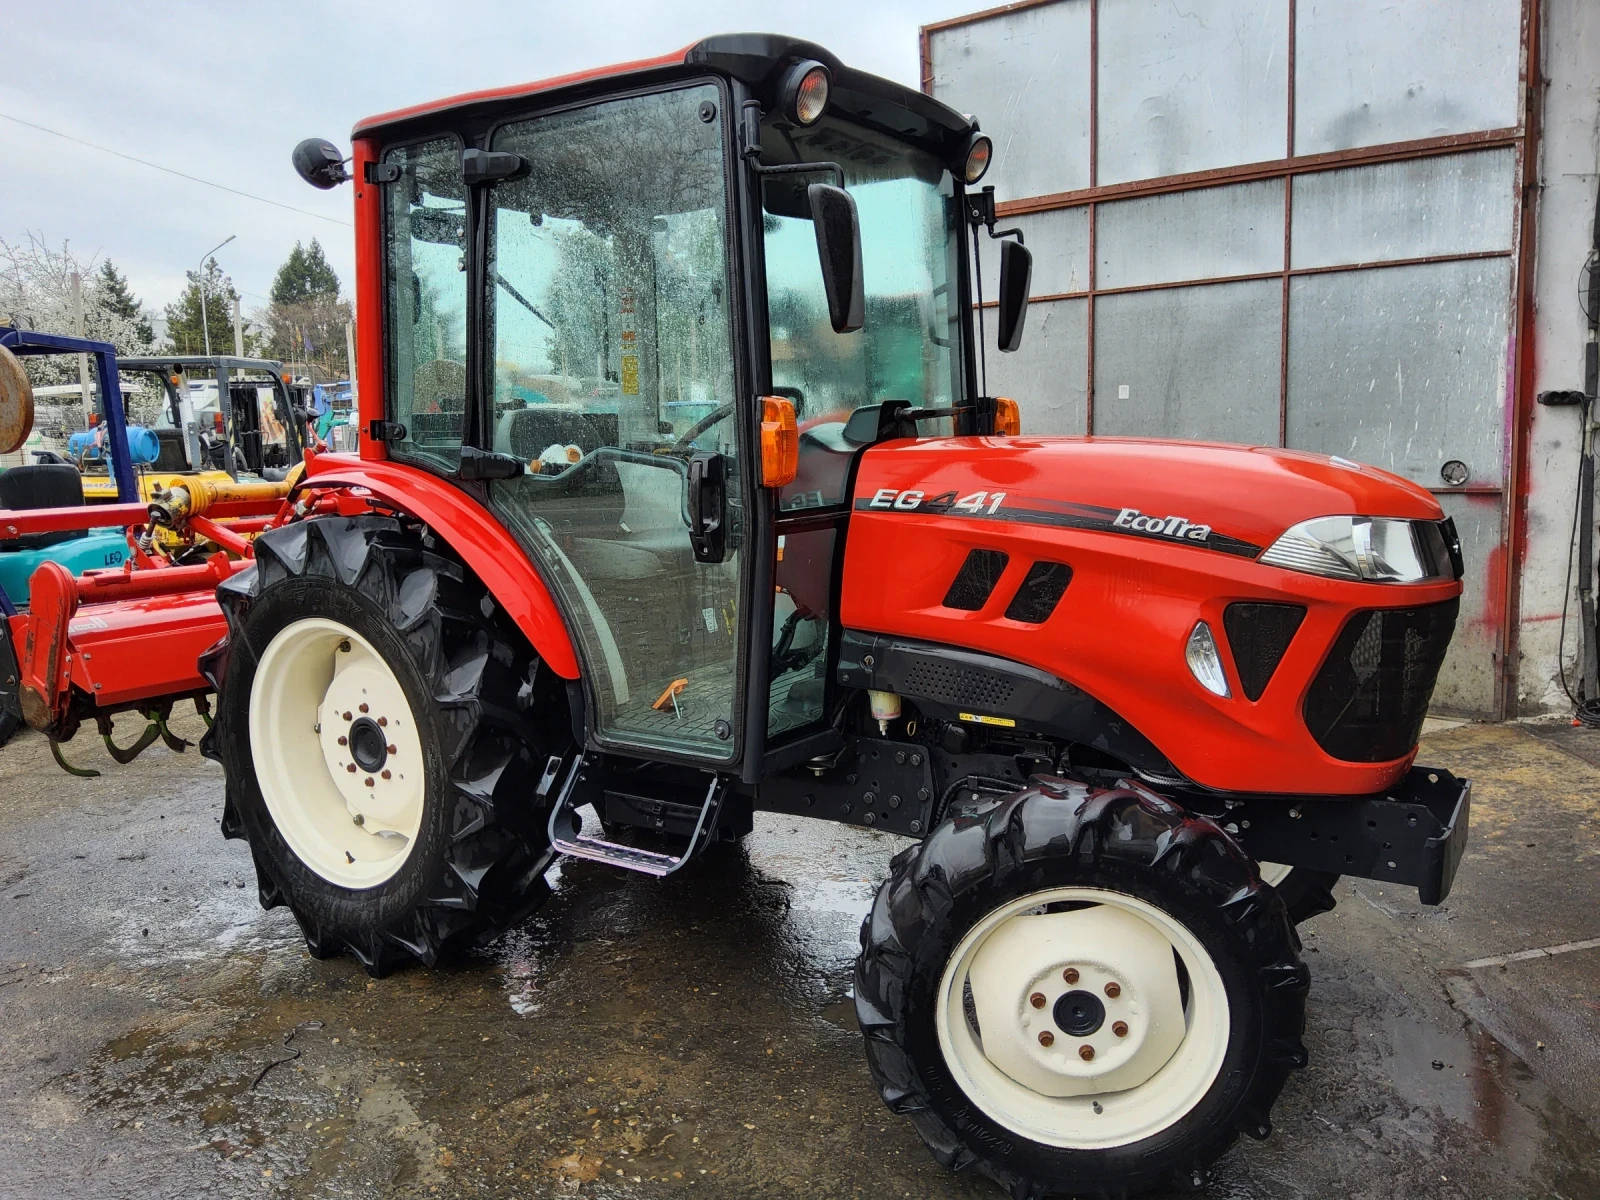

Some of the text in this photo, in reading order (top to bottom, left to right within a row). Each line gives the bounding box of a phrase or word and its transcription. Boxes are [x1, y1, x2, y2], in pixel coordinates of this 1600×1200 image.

[869, 488, 1007, 515] EG 441
[1112, 507, 1212, 541] EcoTra
